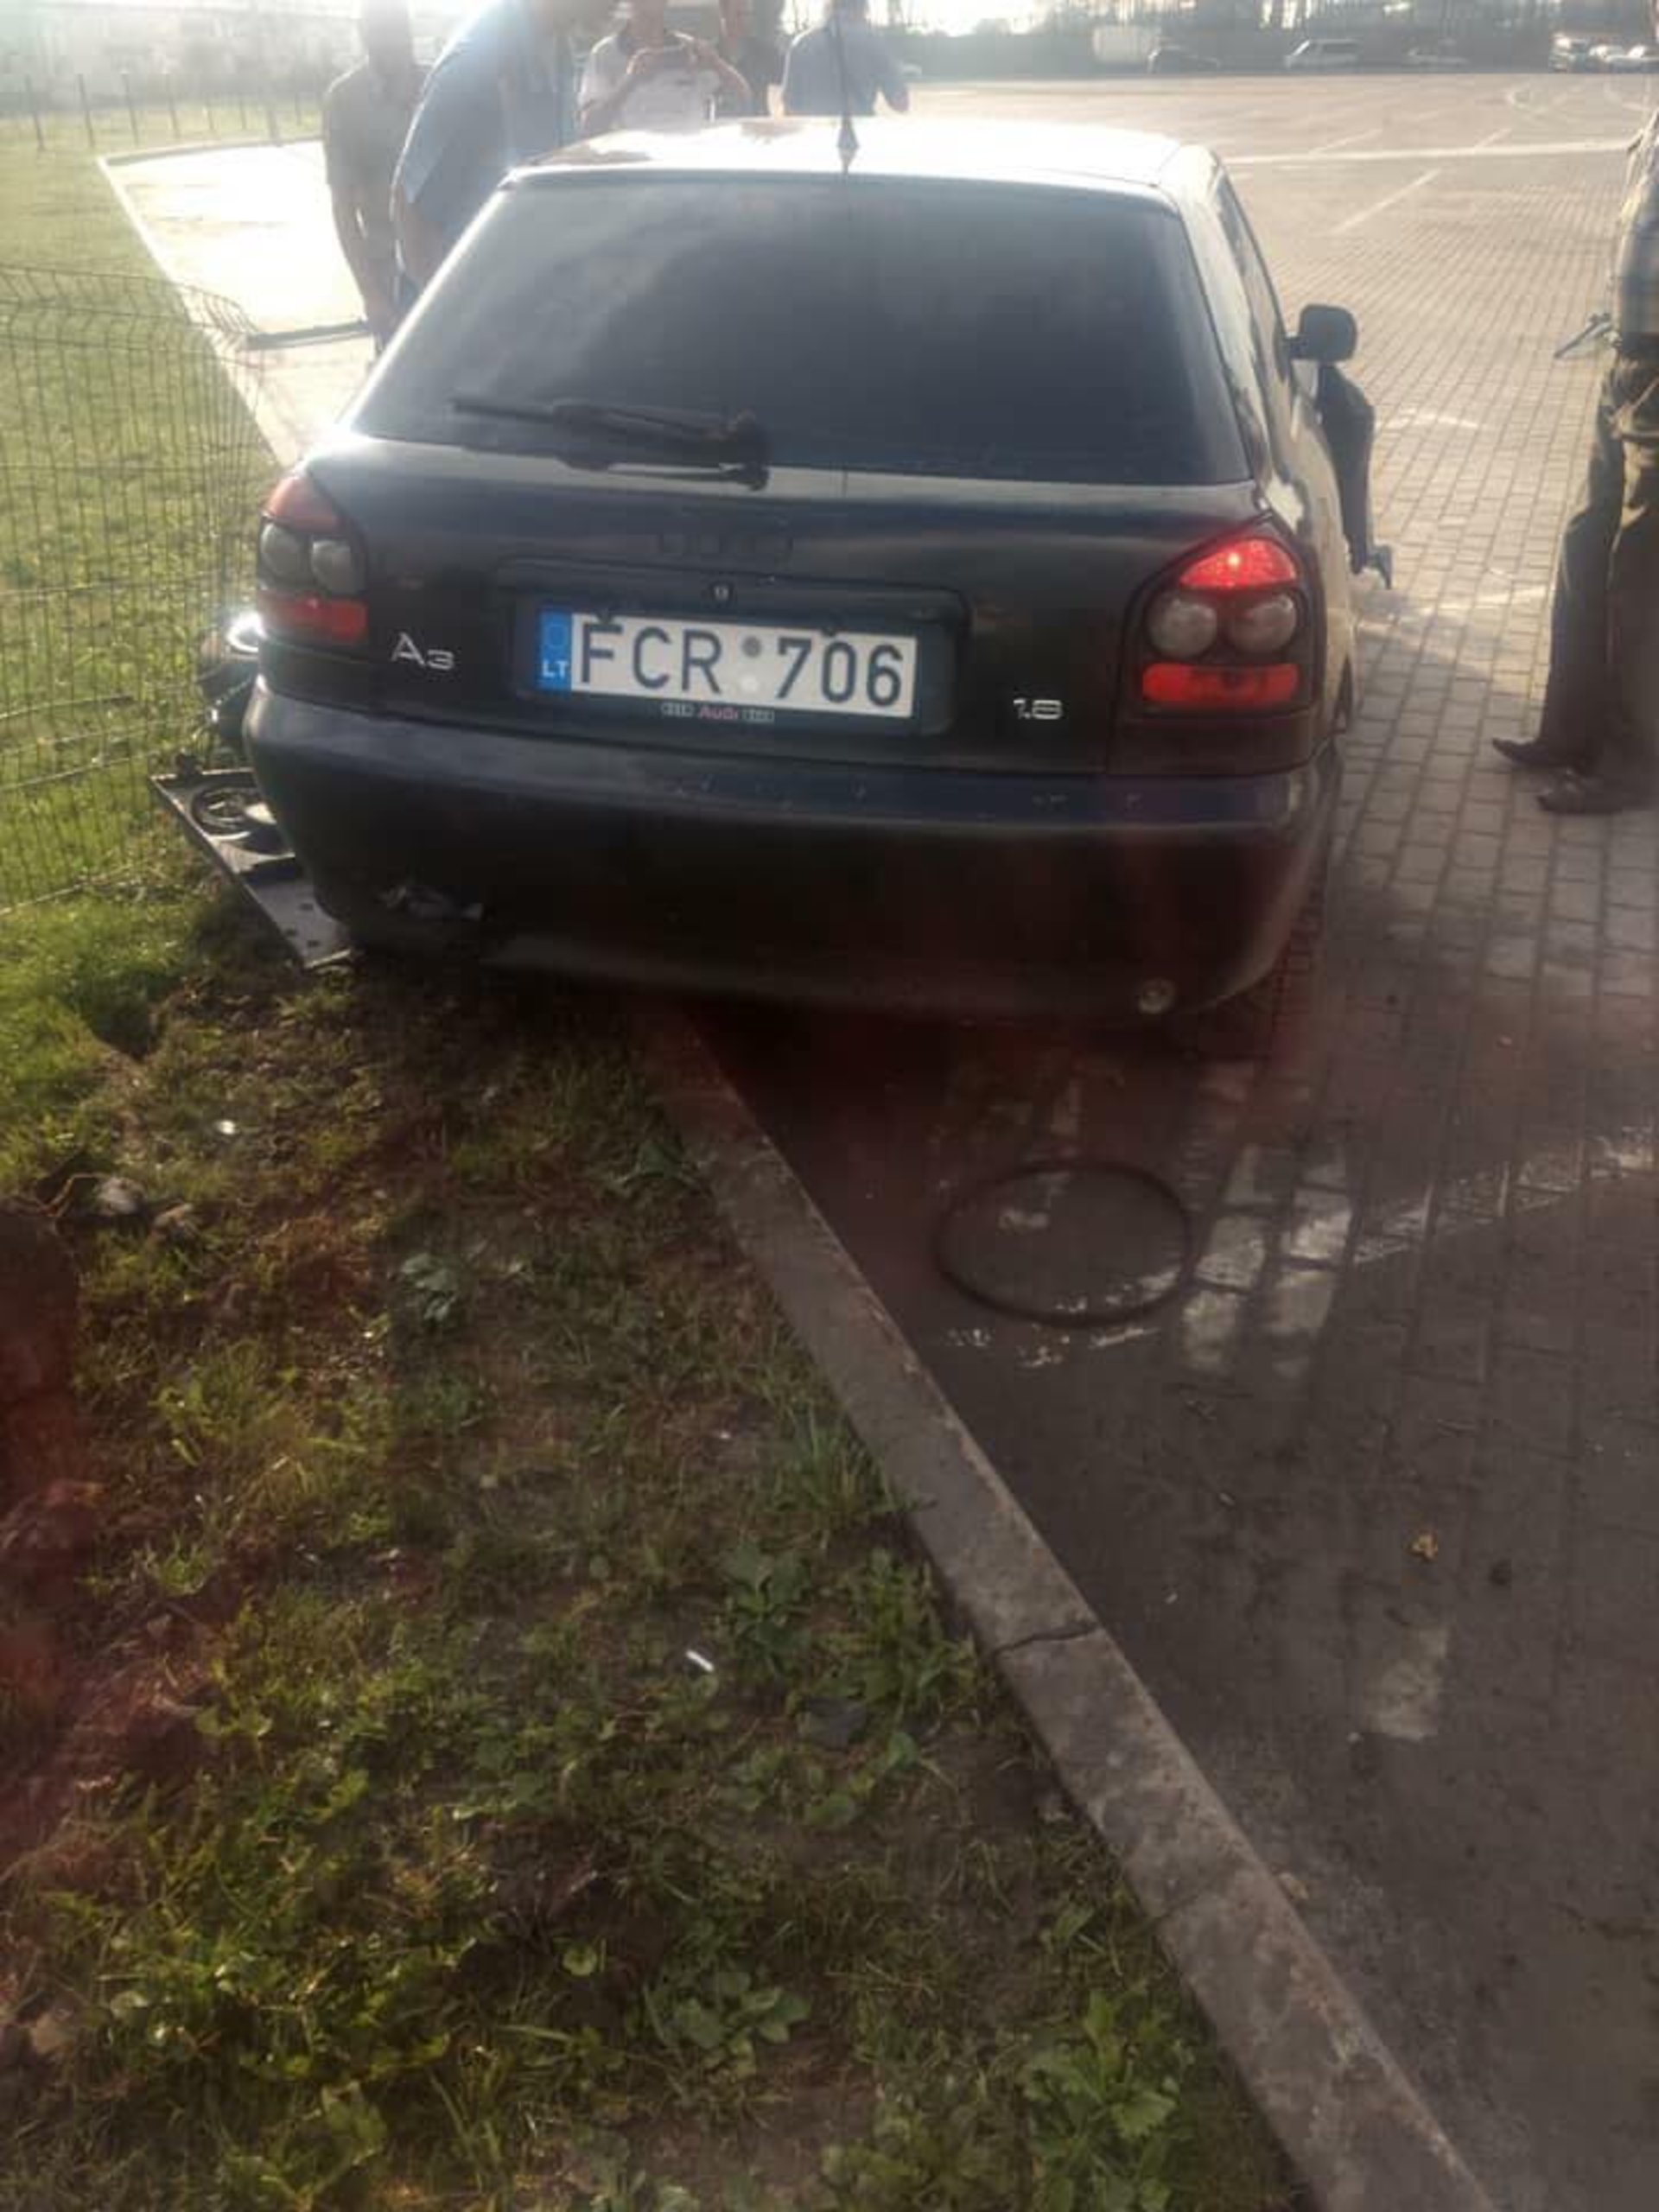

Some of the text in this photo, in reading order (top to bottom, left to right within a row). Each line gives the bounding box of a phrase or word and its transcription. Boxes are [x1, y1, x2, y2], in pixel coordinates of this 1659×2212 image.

[391, 632, 454, 671] A3
[581, 621, 905, 707] FCR 706
[542, 658, 569, 679] LT
[698, 704, 740, 721] Audi
